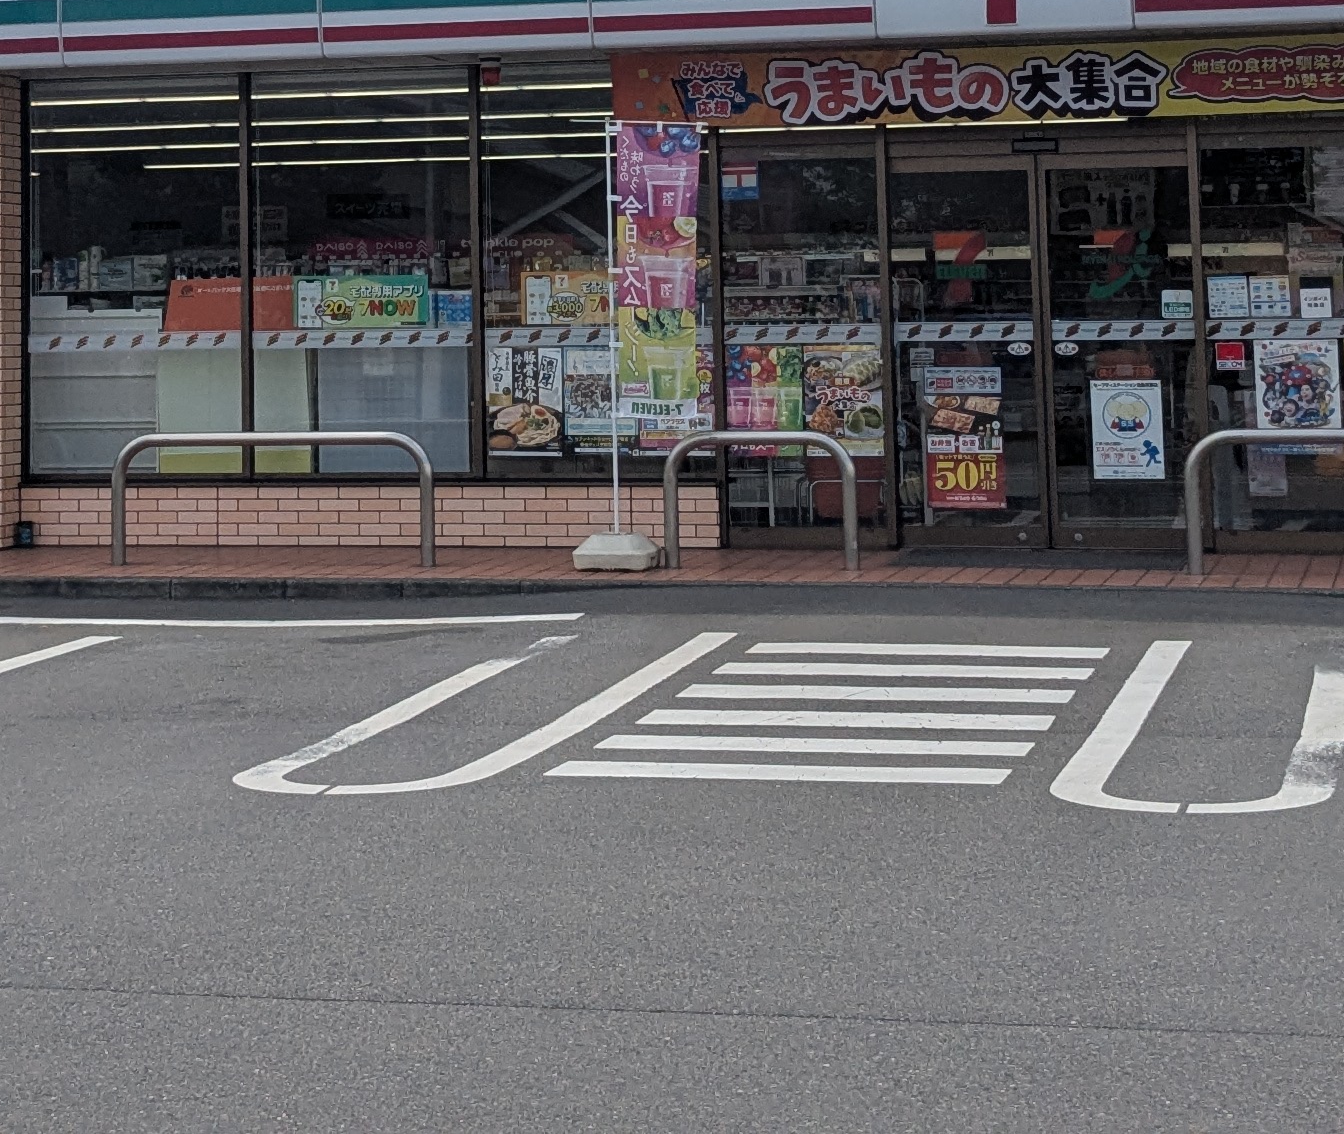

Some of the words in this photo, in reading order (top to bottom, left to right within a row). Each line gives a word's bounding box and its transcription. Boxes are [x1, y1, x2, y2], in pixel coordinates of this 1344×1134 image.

[680, 61, 743, 78] みんなで
[687, 80, 735, 98] 食べて
[695, 97, 732, 117] 応援
[521, 237, 555, 249] pop
[815, 385, 872, 405] うまいもの
